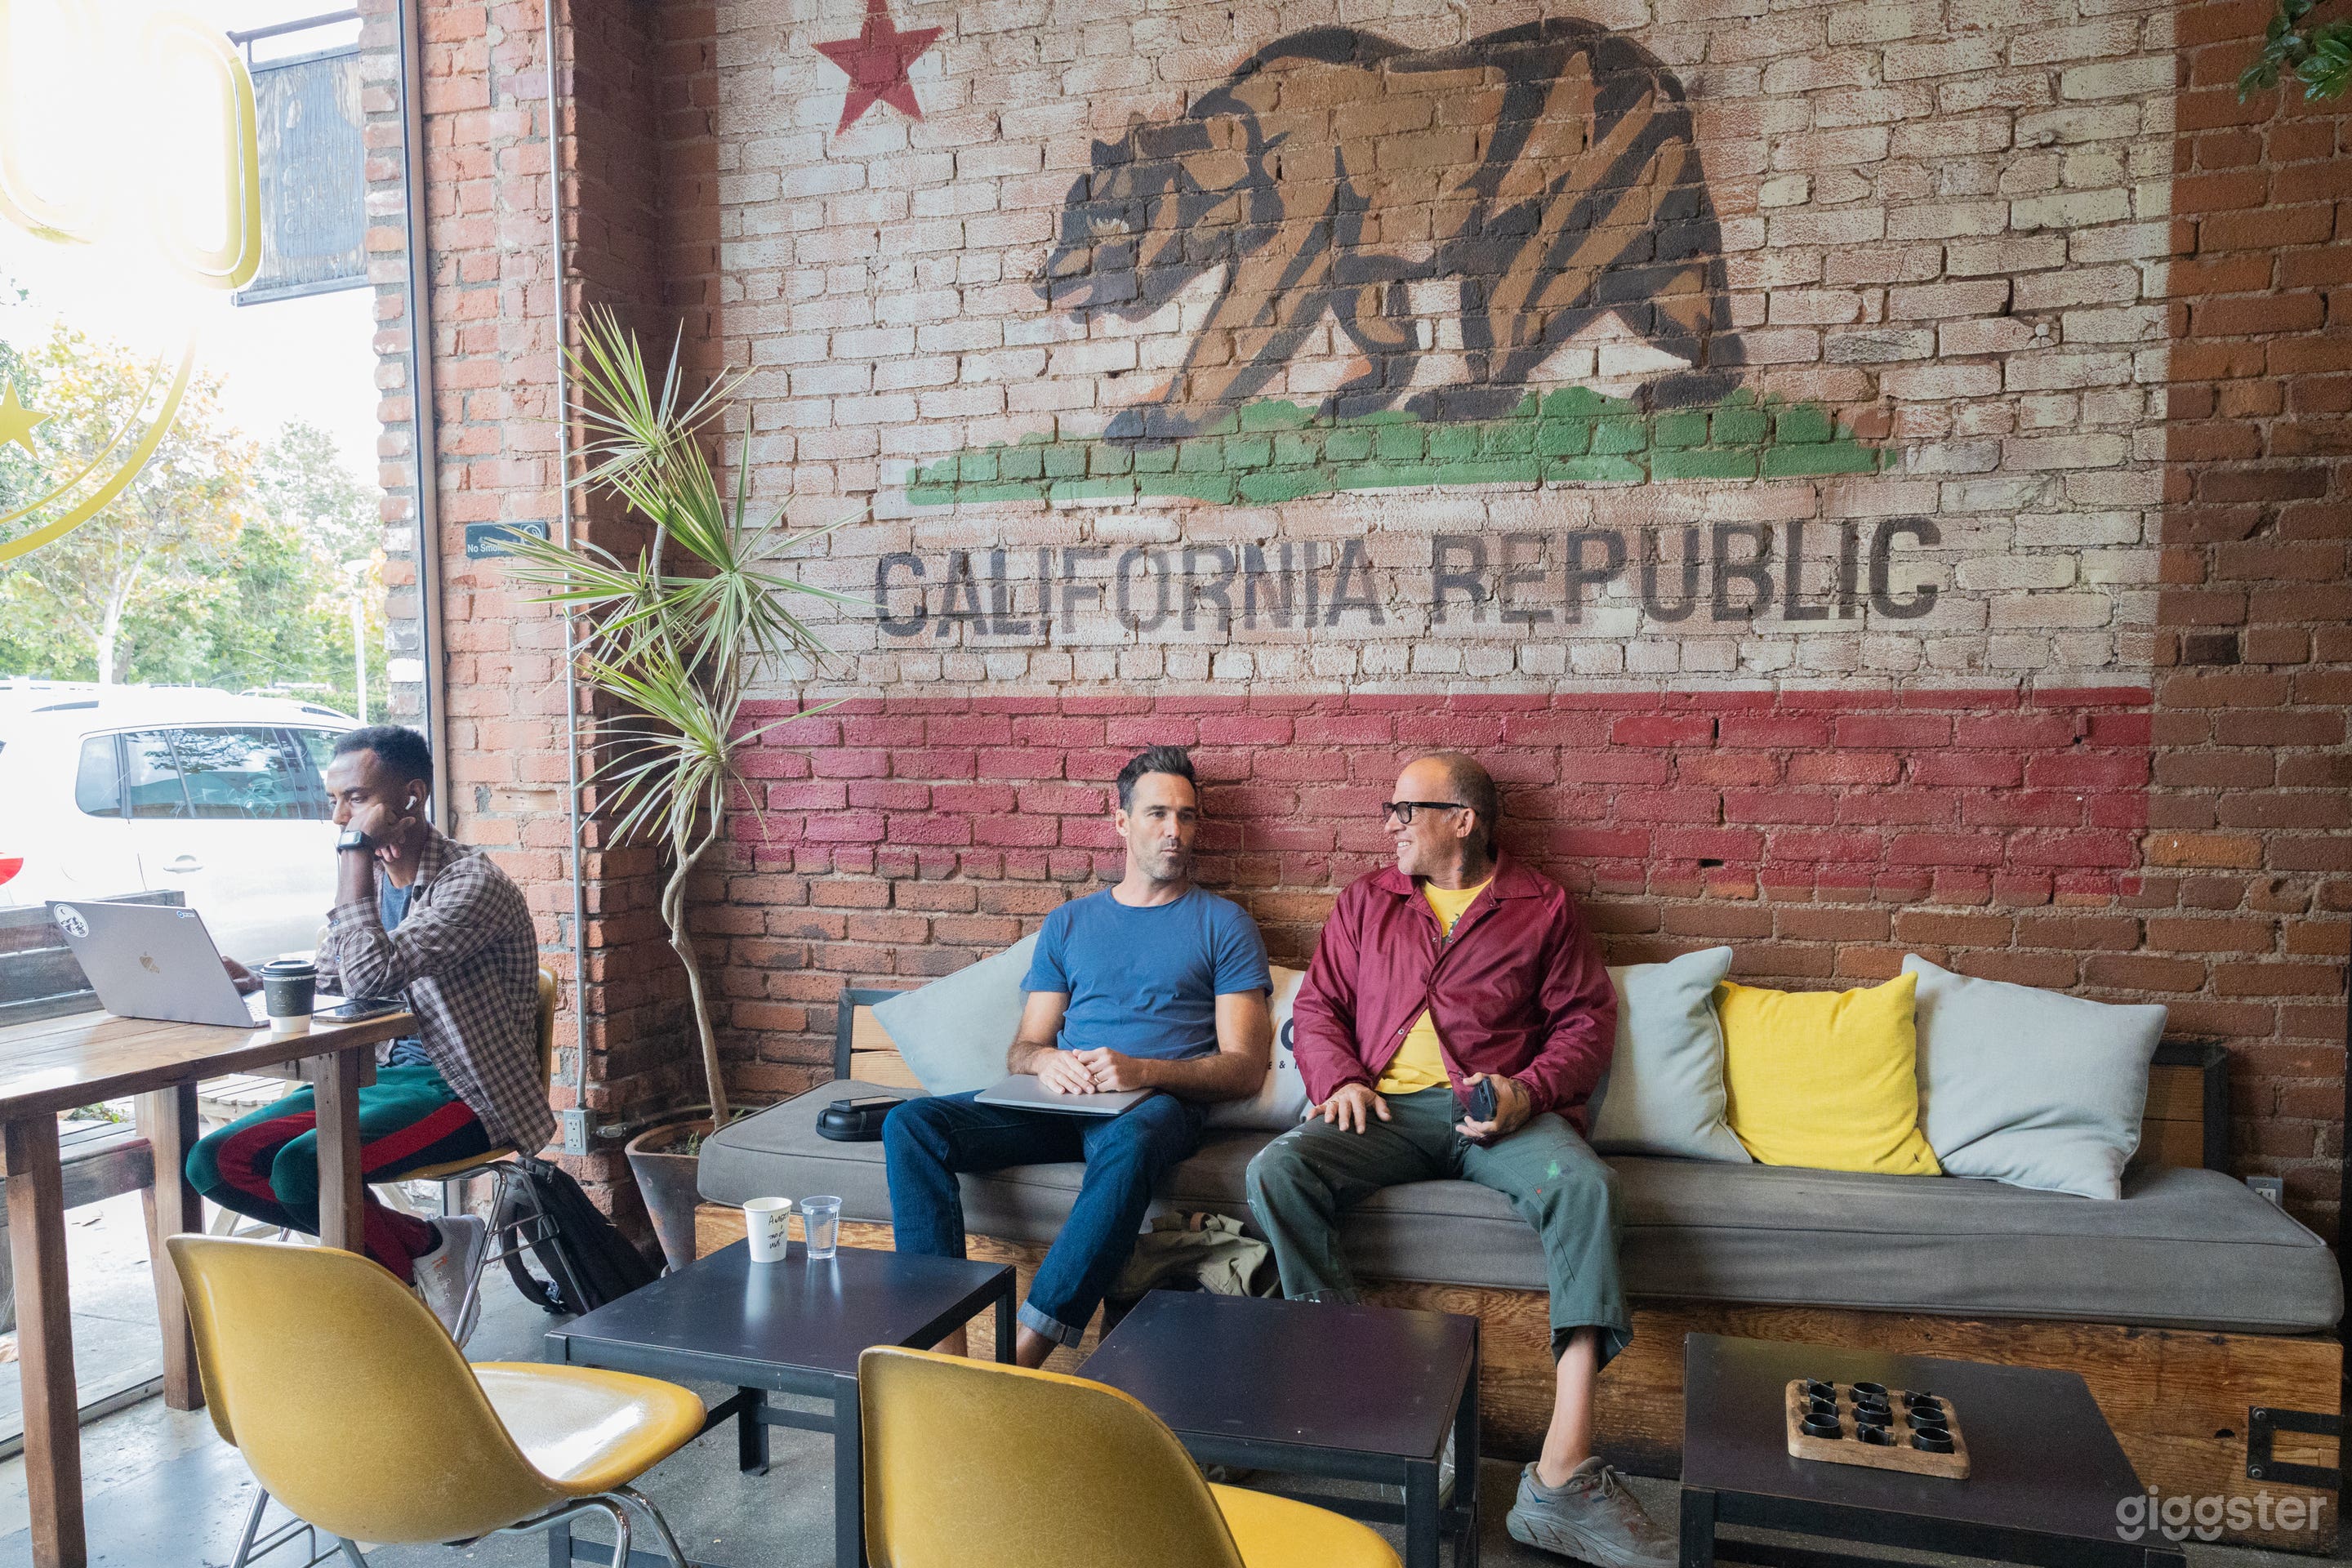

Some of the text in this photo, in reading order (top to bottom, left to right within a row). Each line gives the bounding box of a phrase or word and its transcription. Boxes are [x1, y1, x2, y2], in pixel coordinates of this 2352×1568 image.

[467, 544, 479, 553] No
[874, 517, 1942, 638] CALIFORNIA REPUBLIC
[1279, 1060, 1286, 1069] &
